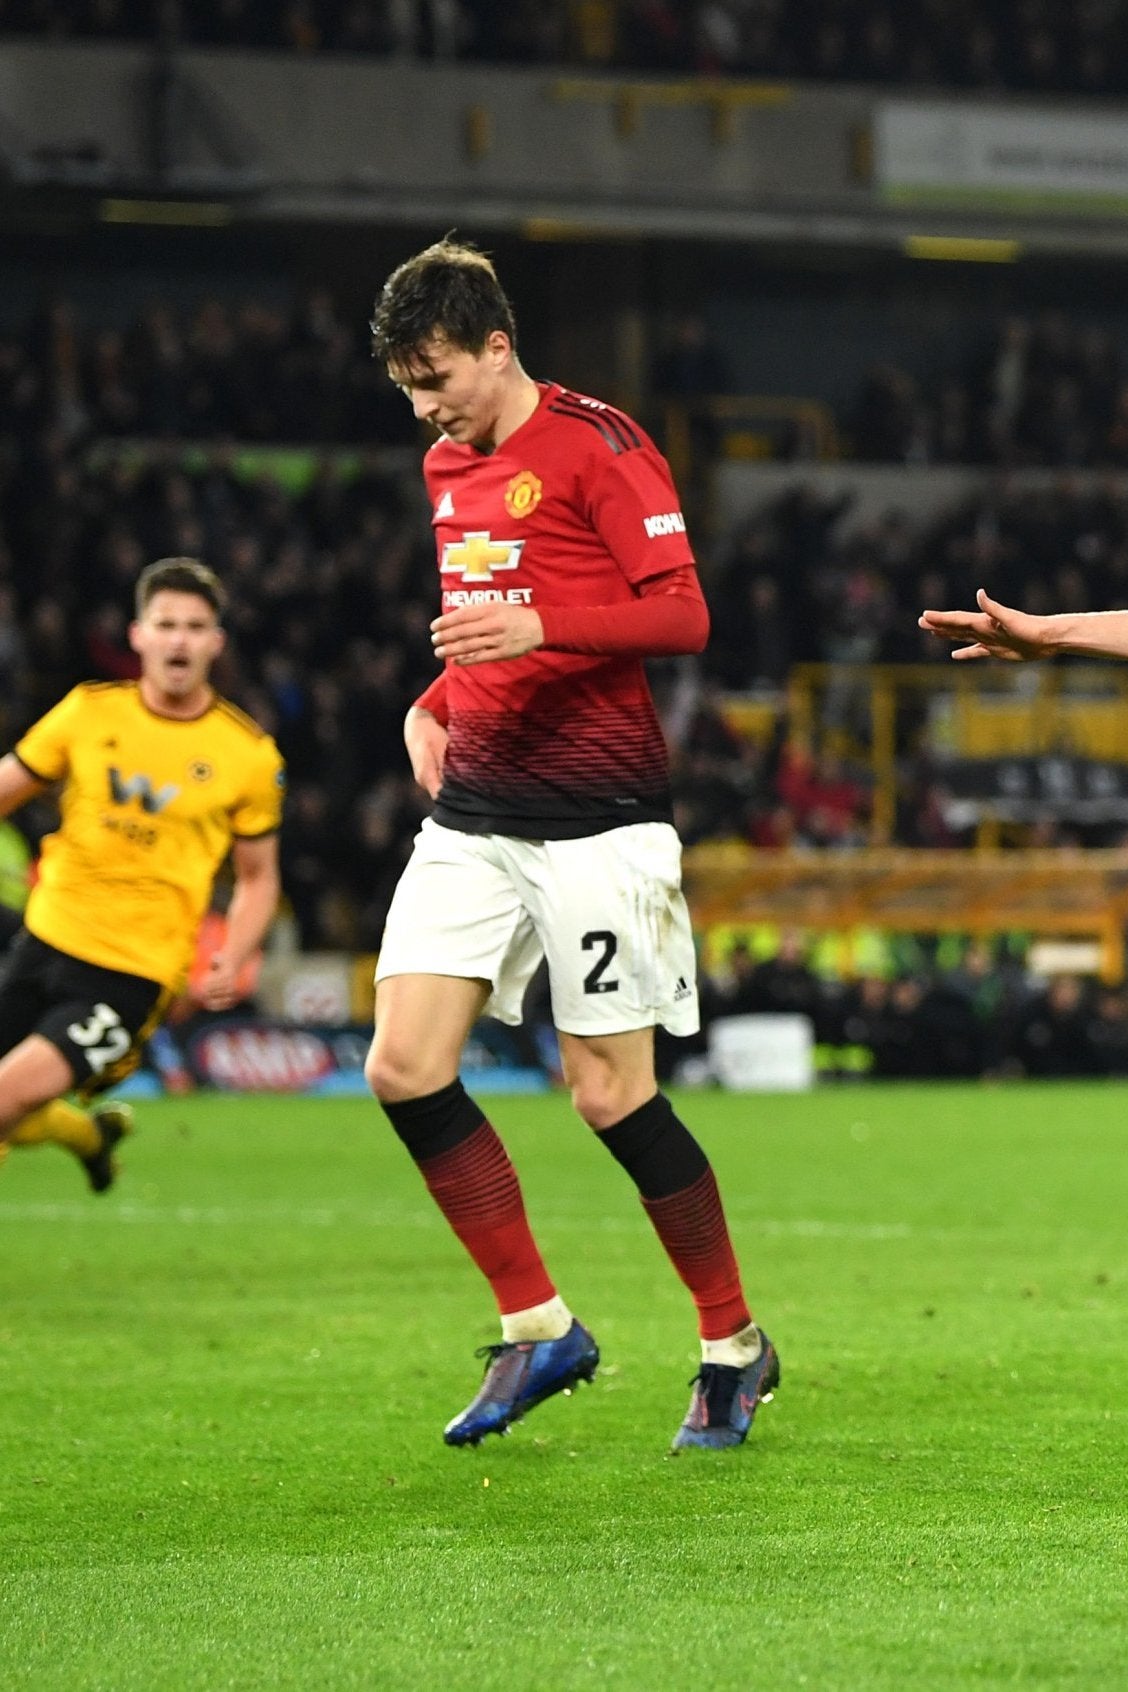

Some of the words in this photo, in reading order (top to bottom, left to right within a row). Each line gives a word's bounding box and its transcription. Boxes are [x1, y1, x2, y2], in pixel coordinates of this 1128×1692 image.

[442, 587, 533, 608] CHEVROLET
[581, 930, 619, 995] 2
[66, 1002, 132, 1074] 32
